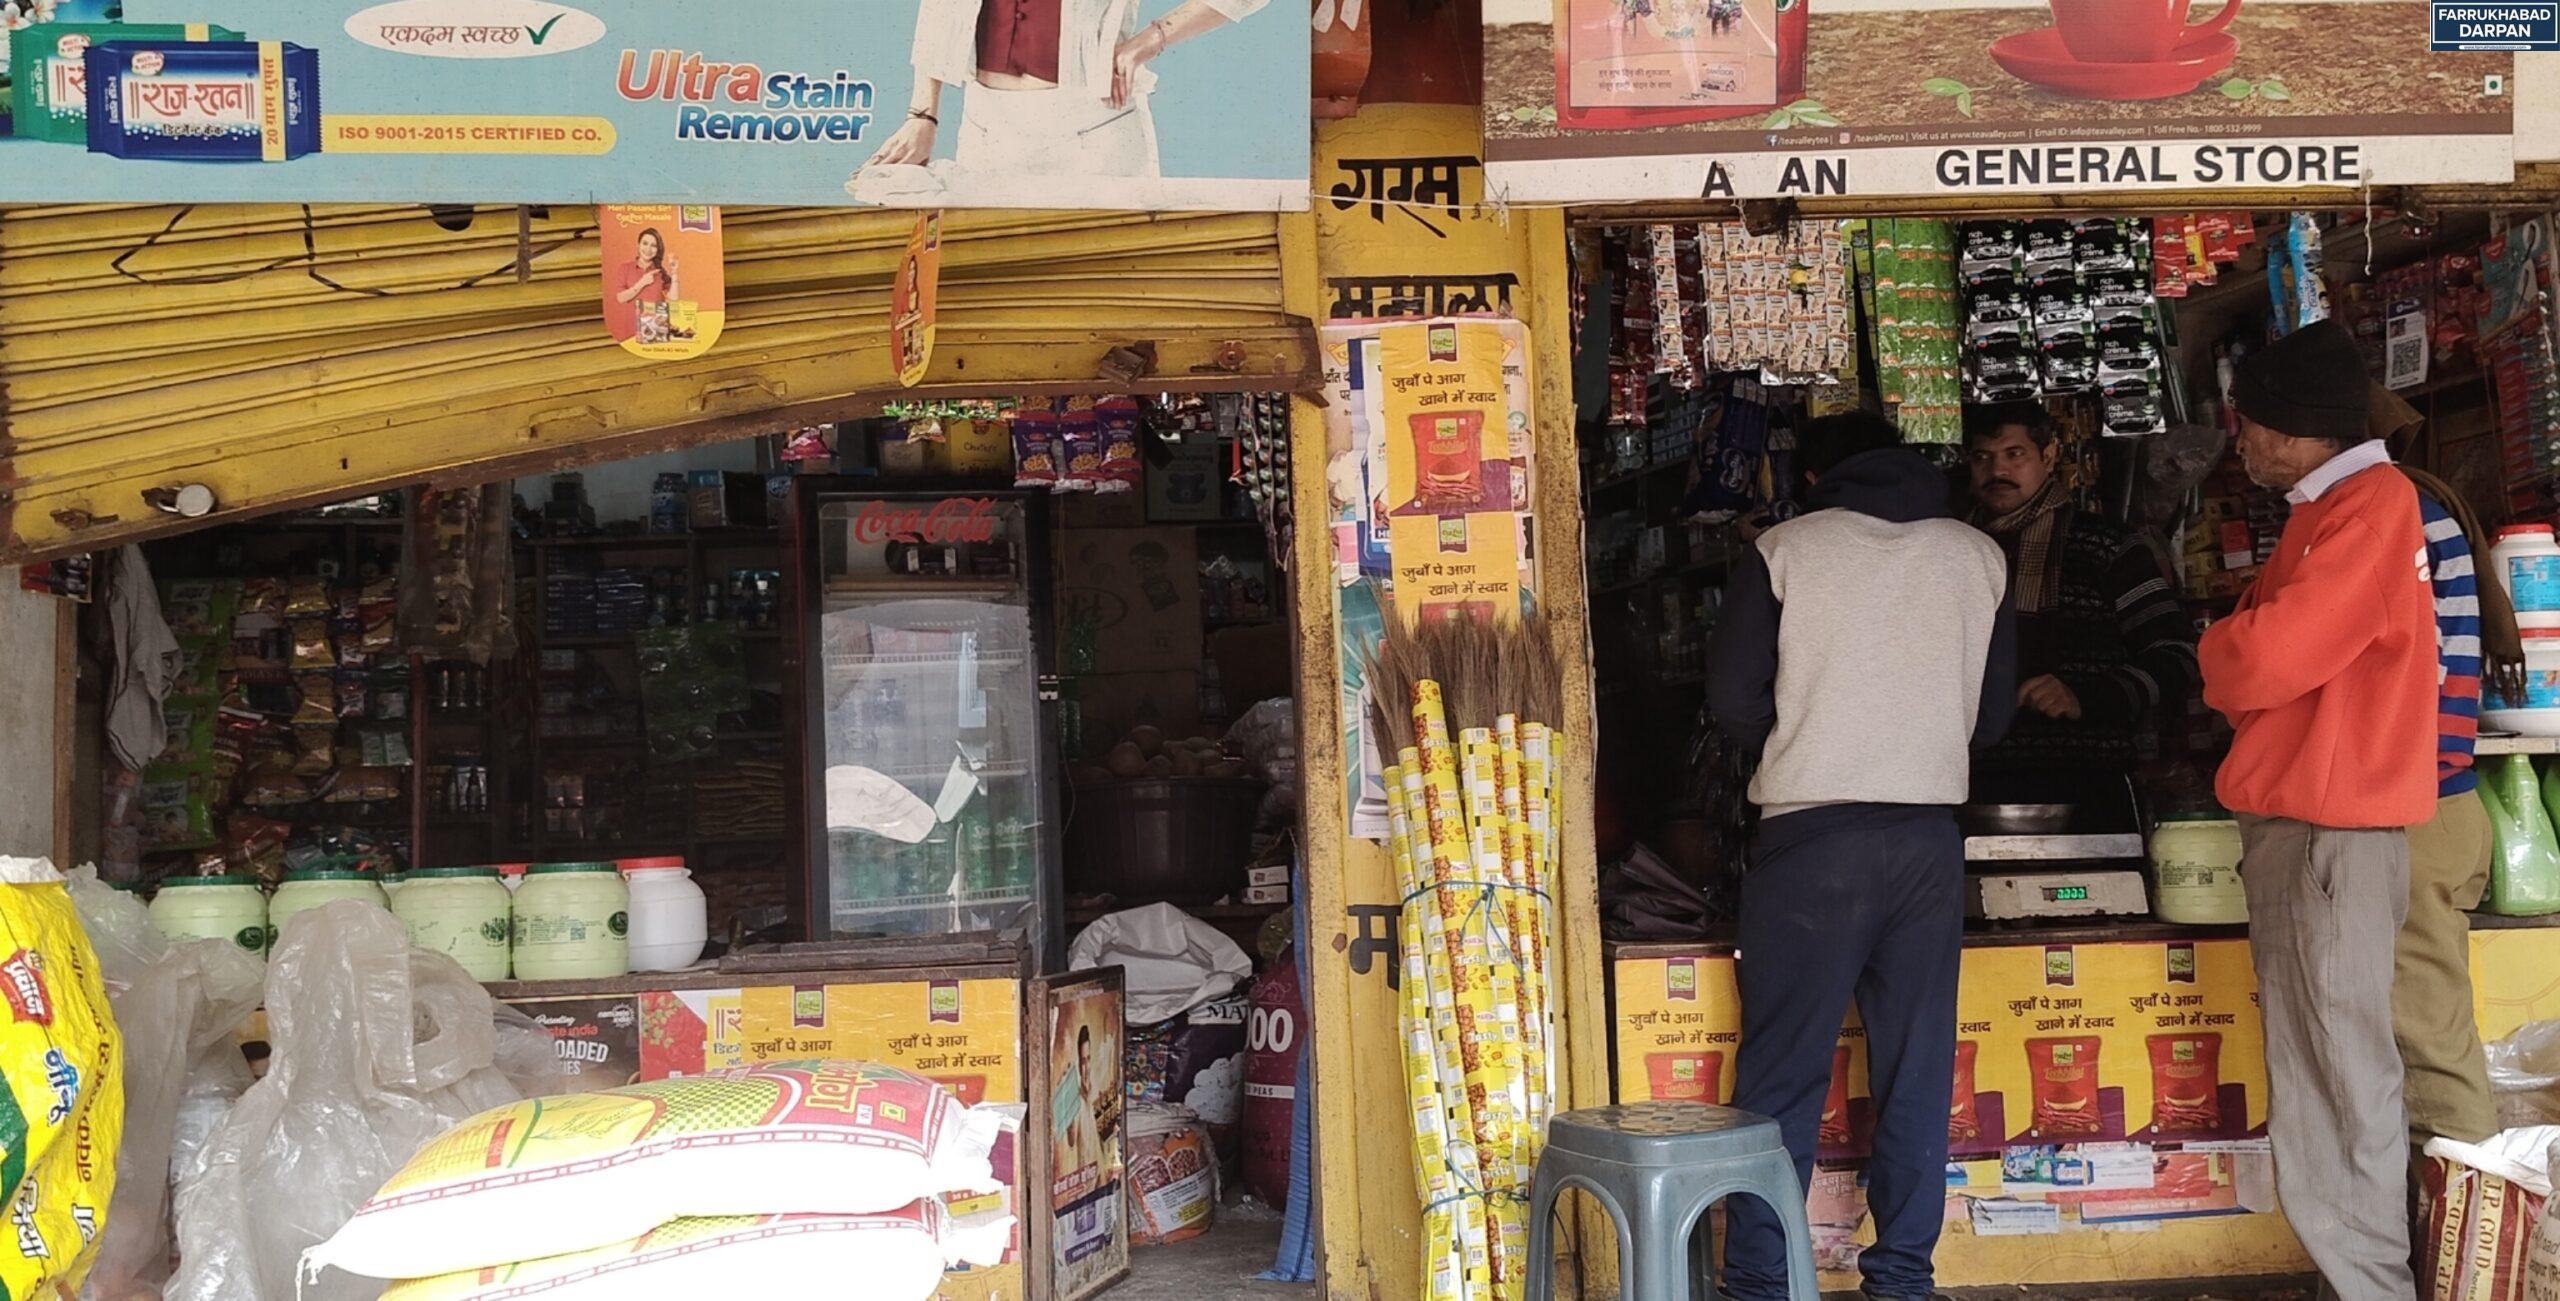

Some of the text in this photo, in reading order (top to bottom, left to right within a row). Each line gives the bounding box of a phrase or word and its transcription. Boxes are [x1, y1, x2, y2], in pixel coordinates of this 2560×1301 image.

[380, 25, 521, 45] एकदम स्वच्छ
[617, 49, 873, 109] Ultra Stain
[678, 105, 871, 141] Remover
[339, 127, 602, 141] ISO 9001-2015 CERTIFIED CO.
[1911, 131, 1928, 140] Visit
[1929, 132, 1939, 140] us
[1950, 129, 2026, 140] www.teavalley.com
[2034, 127, 2054, 137] Email
[2070, 126, 2145, 138] info@teavalley.com
[2154, 125, 2167, 134] Toll
[2169, 125, 2185, 134] Free
[2204, 123, 2262, 134] 1800-532-9999
[1701, 160, 1735, 198] A
[1937, 146, 2177, 186] GENERAL
[2194, 144, 2361, 183] STORE
[1968, 230, 1984, 239] rich
[2029, 231, 2044, 240] rich
[2080, 242, 2095, 251] rich
[2100, 277, 2115, 286] rich
[1975, 293, 1990, 302] rich
[2039, 294, 2054, 302] rich
[2105, 340, 2120, 348] rich
[1981, 356, 1997, 366] rich
[1423, 372, 1433, 385] पे
[1436, 373, 1466, 384] आग
[1418, 389, 1497, 406] खाने में स्वाद
[2108, 403, 2124, 413] rich
[1433, 563, 1443, 576] पे
[1447, 564, 1476, 575] आग
[1428, 580, 1508, 596] खाने में स्वाद
[2040, 996, 2050, 1010] पे
[2053, 998, 2082, 1010] आग
[2161, 993, 2171, 1007] पे
[2175, 994, 2203, 1006] आग
[1661, 1010, 1670, 1024] पे
[1674, 1013, 1704, 1023] आग
[2035, 1014, 2116, 1031] खाने में स्वाद
[2155, 1011, 2236, 1027] खाने में स्वाद
[1960, 1021, 1991, 1033] स्वाद
[922, 1034, 932, 1048] पे
[936, 1035, 968, 1048] आग
[1655, 1029, 1738, 1045] खाने में स्वाद
[555, 1039, 609, 1063] OADED
[786, 1038, 796, 1052] पे
[800, 1040, 832, 1051] आग
[915, 1052, 1002, 1069] खाने में स्वाद
[2442, 1206, 2461, 1257] GOLD
[2474, 1217, 2496, 1269] GOLD
